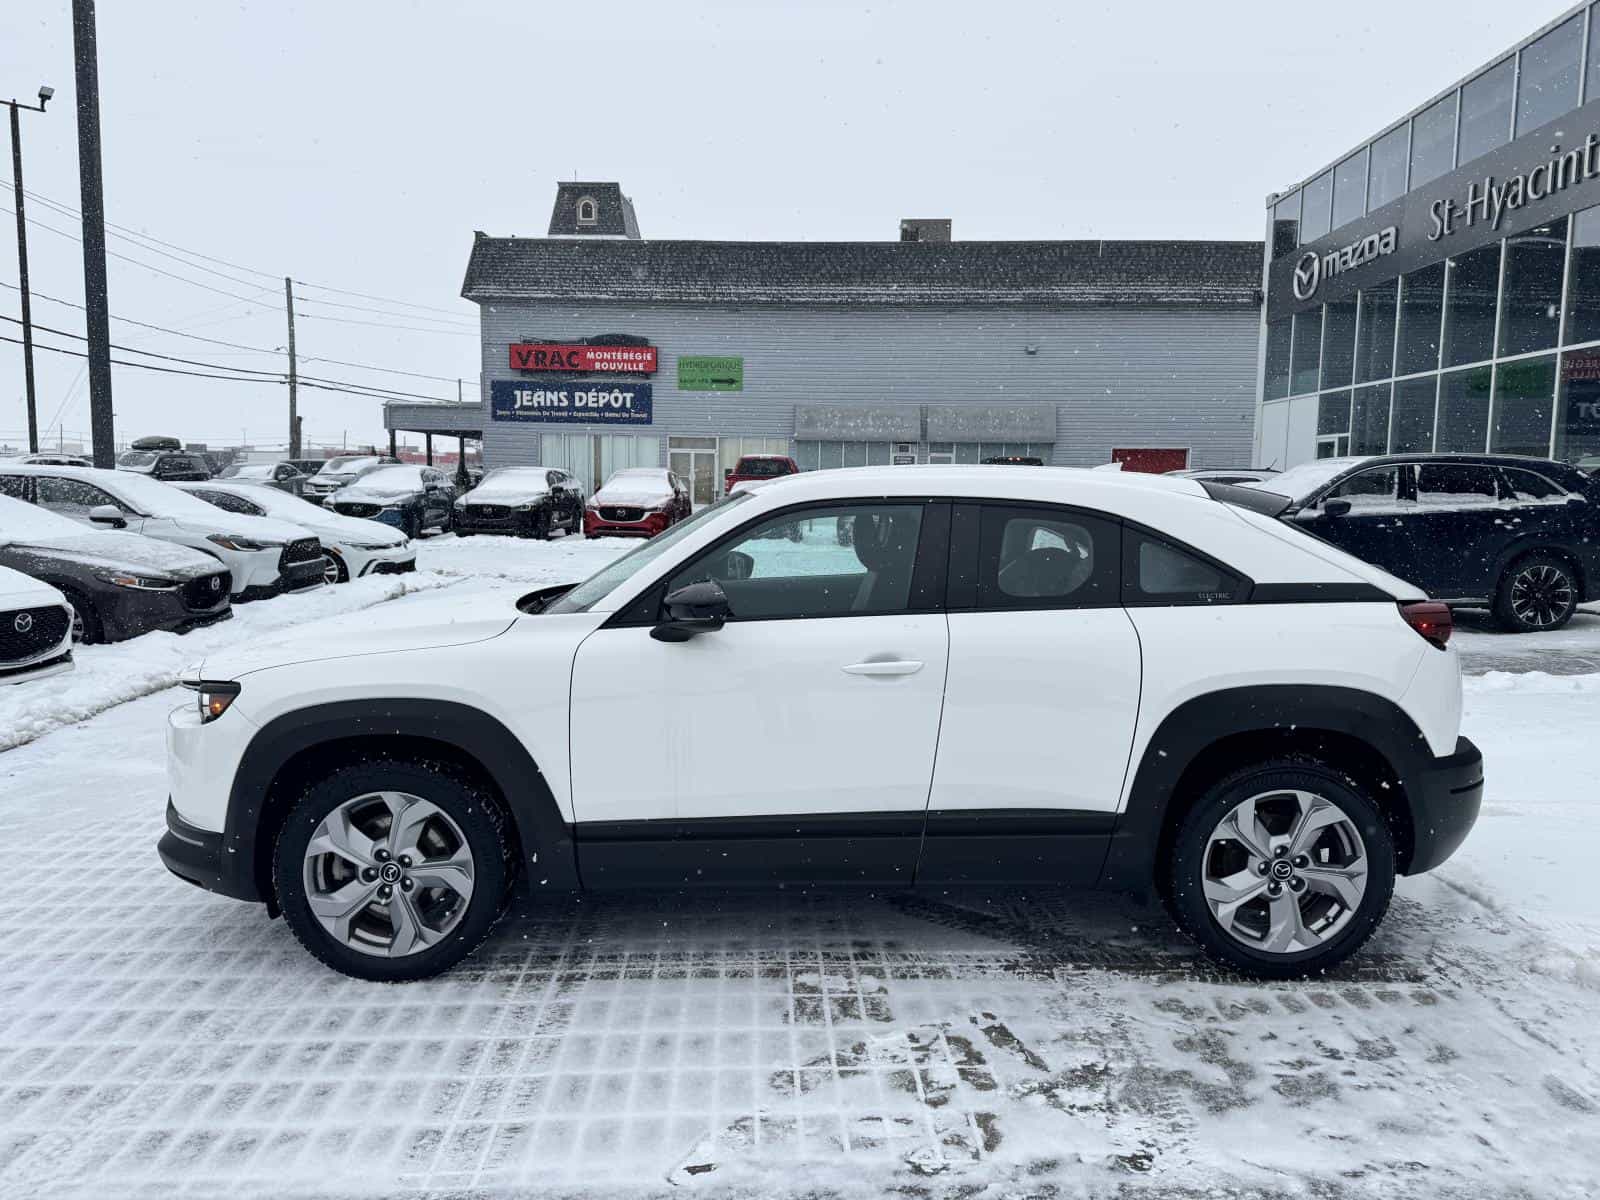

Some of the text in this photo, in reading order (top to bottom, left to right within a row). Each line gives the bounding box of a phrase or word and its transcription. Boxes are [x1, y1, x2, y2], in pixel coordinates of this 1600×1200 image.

[1427, 132, 1600, 241] St-Hyacint
[1321, 226, 1397, 279] mazda
[516, 350, 580, 368] VRAC
[595, 362, 644, 370] ROUVILLE
[513, 388, 634, 409] JEANS DÉPÔT
